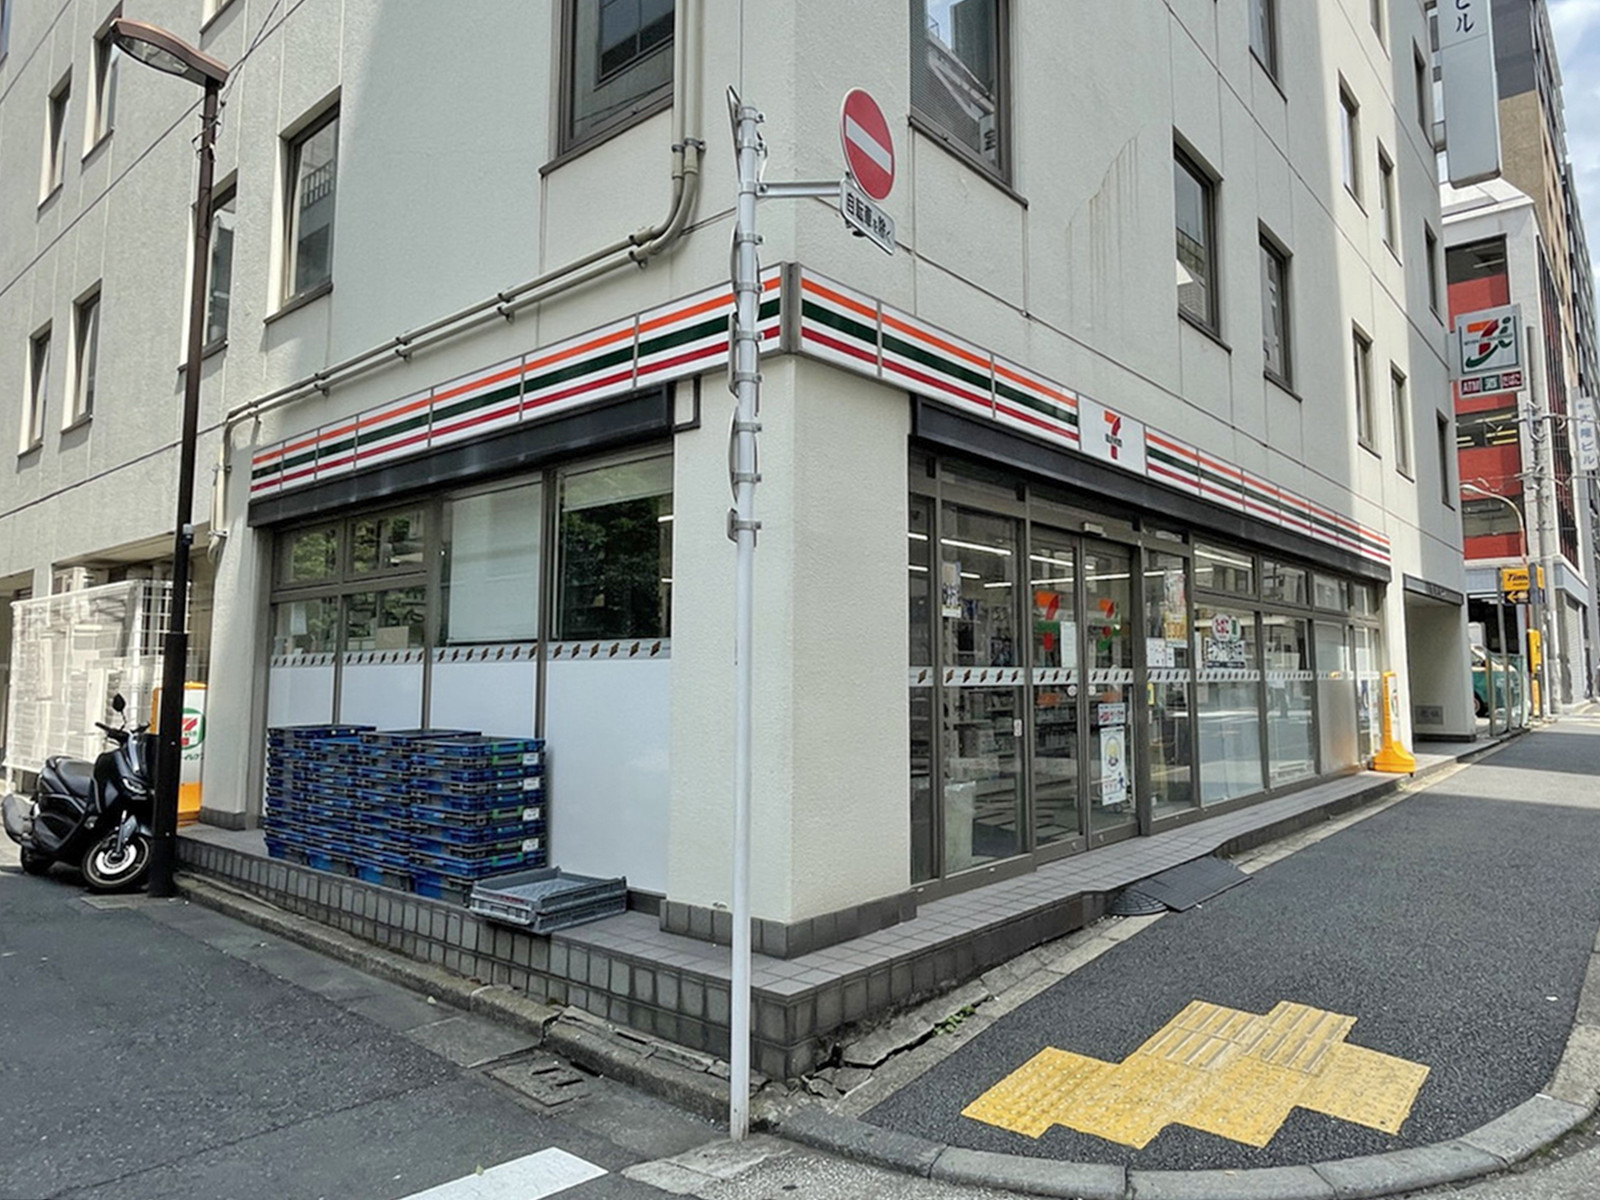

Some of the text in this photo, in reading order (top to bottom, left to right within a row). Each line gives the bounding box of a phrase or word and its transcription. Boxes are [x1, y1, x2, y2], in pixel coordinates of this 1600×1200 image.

[846, 192, 892, 245] 自転車を除く
